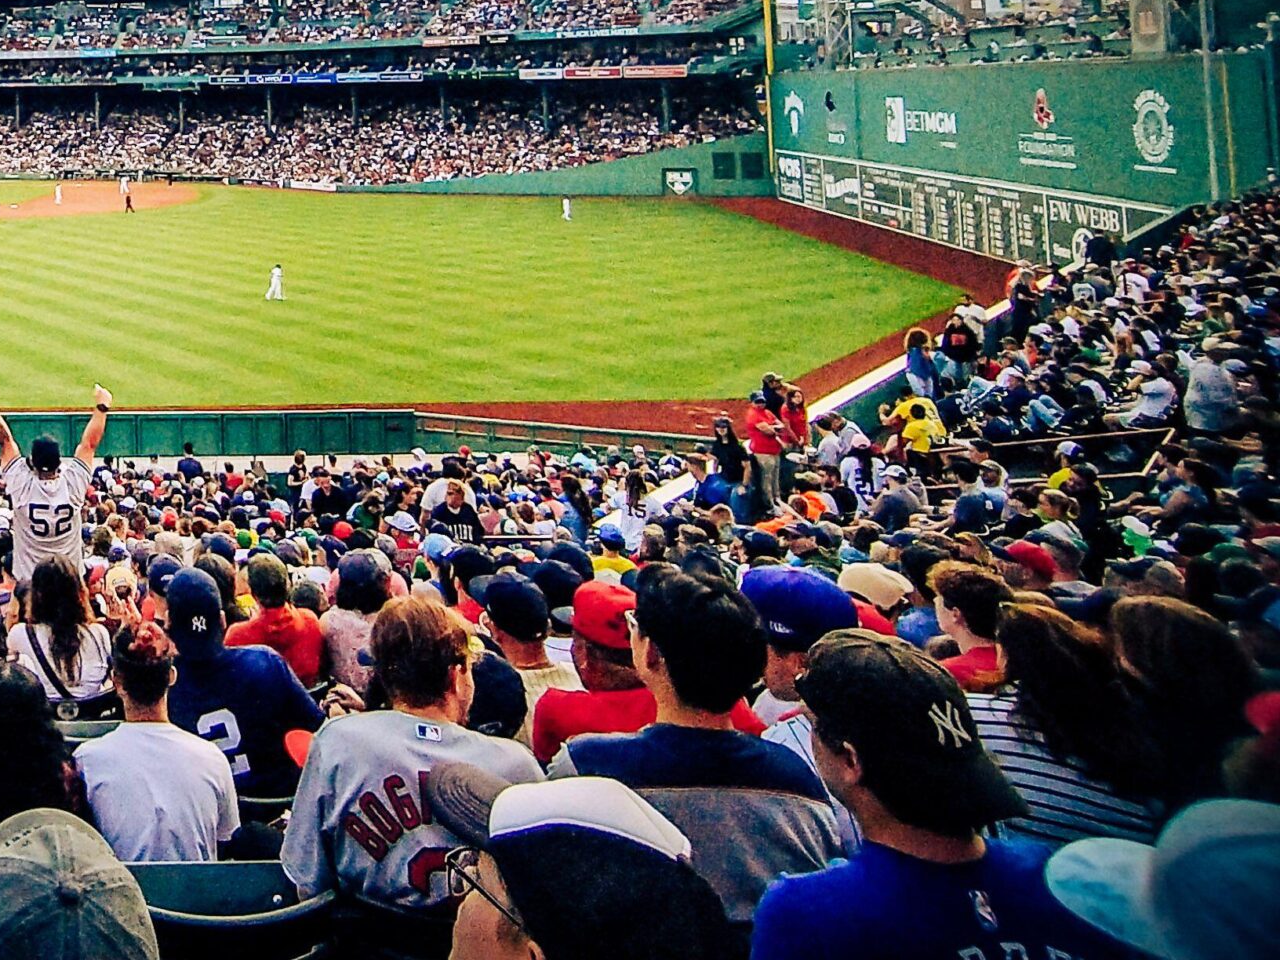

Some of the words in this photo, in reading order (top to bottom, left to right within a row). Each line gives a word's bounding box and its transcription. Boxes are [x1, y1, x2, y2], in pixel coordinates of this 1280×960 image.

[906, 110, 958, 134] BETMGM
[1074, 203, 1120, 232] WEBB
[29, 503, 74, 537] 52
[626, 503, 647, 519] 15
[197, 708, 251, 776] 2
